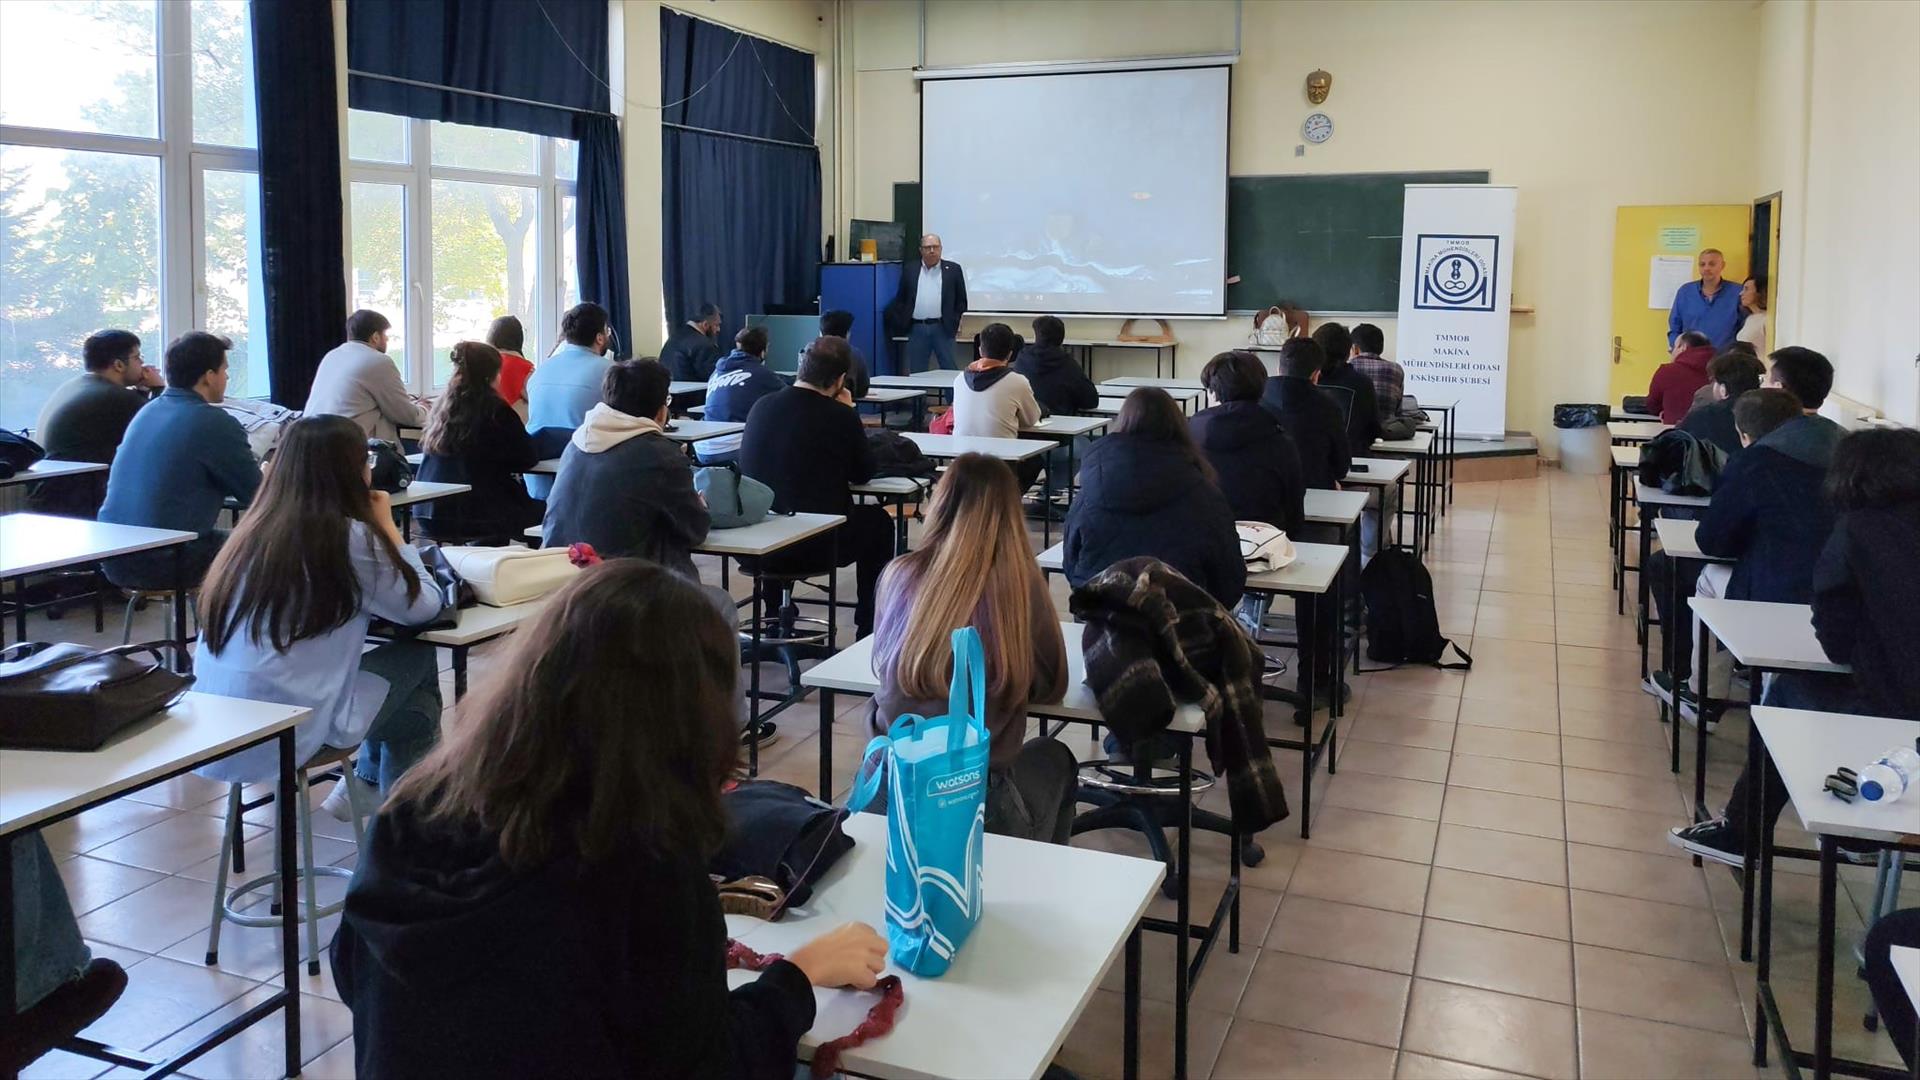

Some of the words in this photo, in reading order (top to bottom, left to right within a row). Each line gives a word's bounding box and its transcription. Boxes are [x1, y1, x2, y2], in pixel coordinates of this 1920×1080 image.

[1435, 334, 1470, 342] TMMOB
[1433, 347, 1470, 356] MAKİNA
[1403, 359, 1470, 370] MÜHENDİSLERİ
[1472, 363, 1501, 372] ODASI
[1410, 373, 1457, 383] ESKİŞEHİR
[935, 770, 980, 790] watsons
